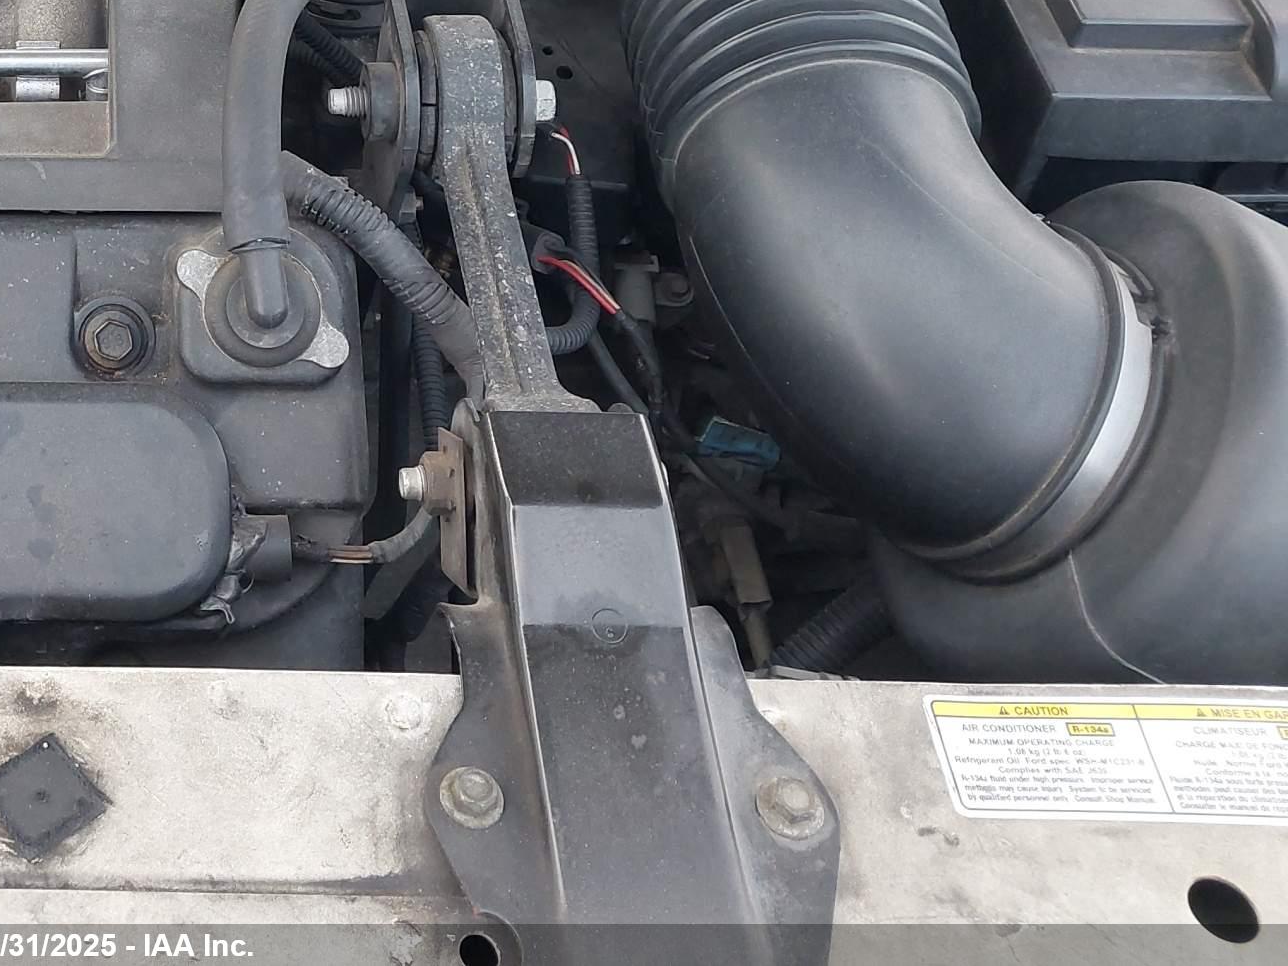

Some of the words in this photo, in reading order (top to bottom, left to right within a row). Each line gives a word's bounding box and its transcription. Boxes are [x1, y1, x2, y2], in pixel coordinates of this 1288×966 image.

[1014, 706, 1068, 716] CAUTION
[1210, 708, 1240, 718] MISE
[1244, 710, 1261, 719] EN
[962, 724, 979, 732] AIR
[982, 724, 1056, 733] CONDITIONER
[1193, 726, 1266, 736] CLIMATISEUR
[968, 738, 1014, 746] MAXIMUM
[1017, 738, 1072, 746] OPERATING
